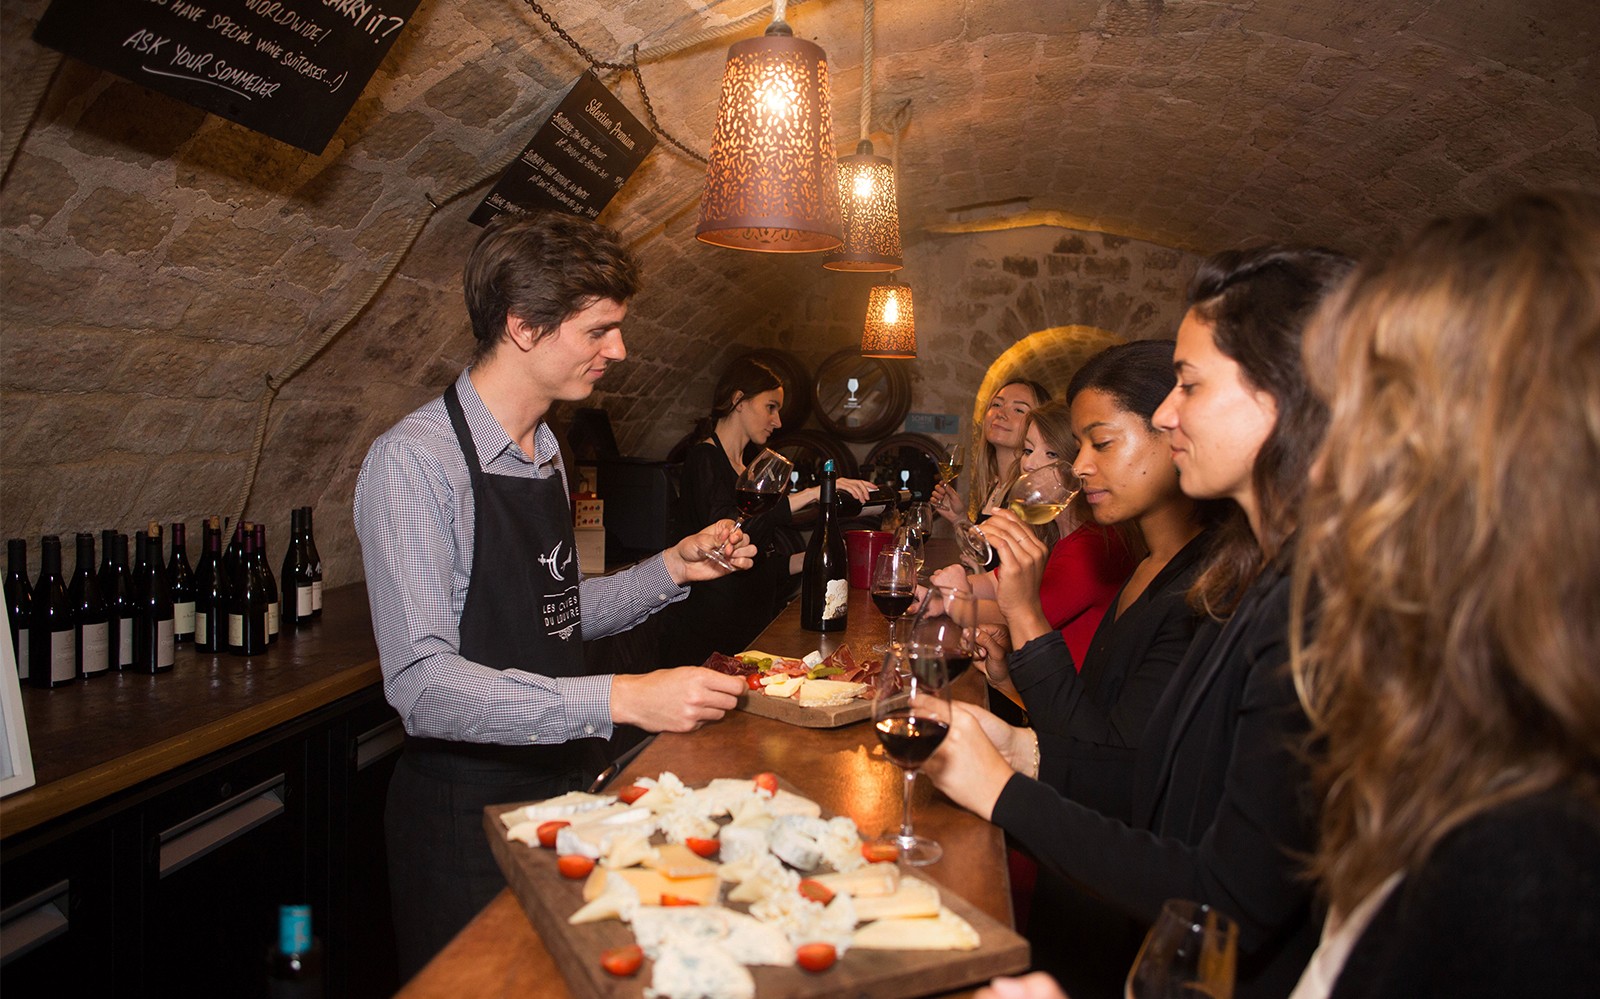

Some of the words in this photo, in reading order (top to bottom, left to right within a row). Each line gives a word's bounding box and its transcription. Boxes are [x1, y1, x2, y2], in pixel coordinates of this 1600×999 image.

[245, 0, 332, 47] WORLDWIDE!
[322, 0, 372, 26] RRY
[170, 0, 206, 21] HAVE
[207, 14, 254, 45] SPECIAL
[256, 38, 283, 59] WINE
[122, 29, 171, 55] ASK
[170, 44, 213, 73] YOUR
[208, 60, 281, 99] SOMMELIER
[609, 121, 636, 151] Premium
[543, 604, 556, 614] LES
[544, 617, 555, 626] DU
[556, 607, 580, 624] LOUVRE
